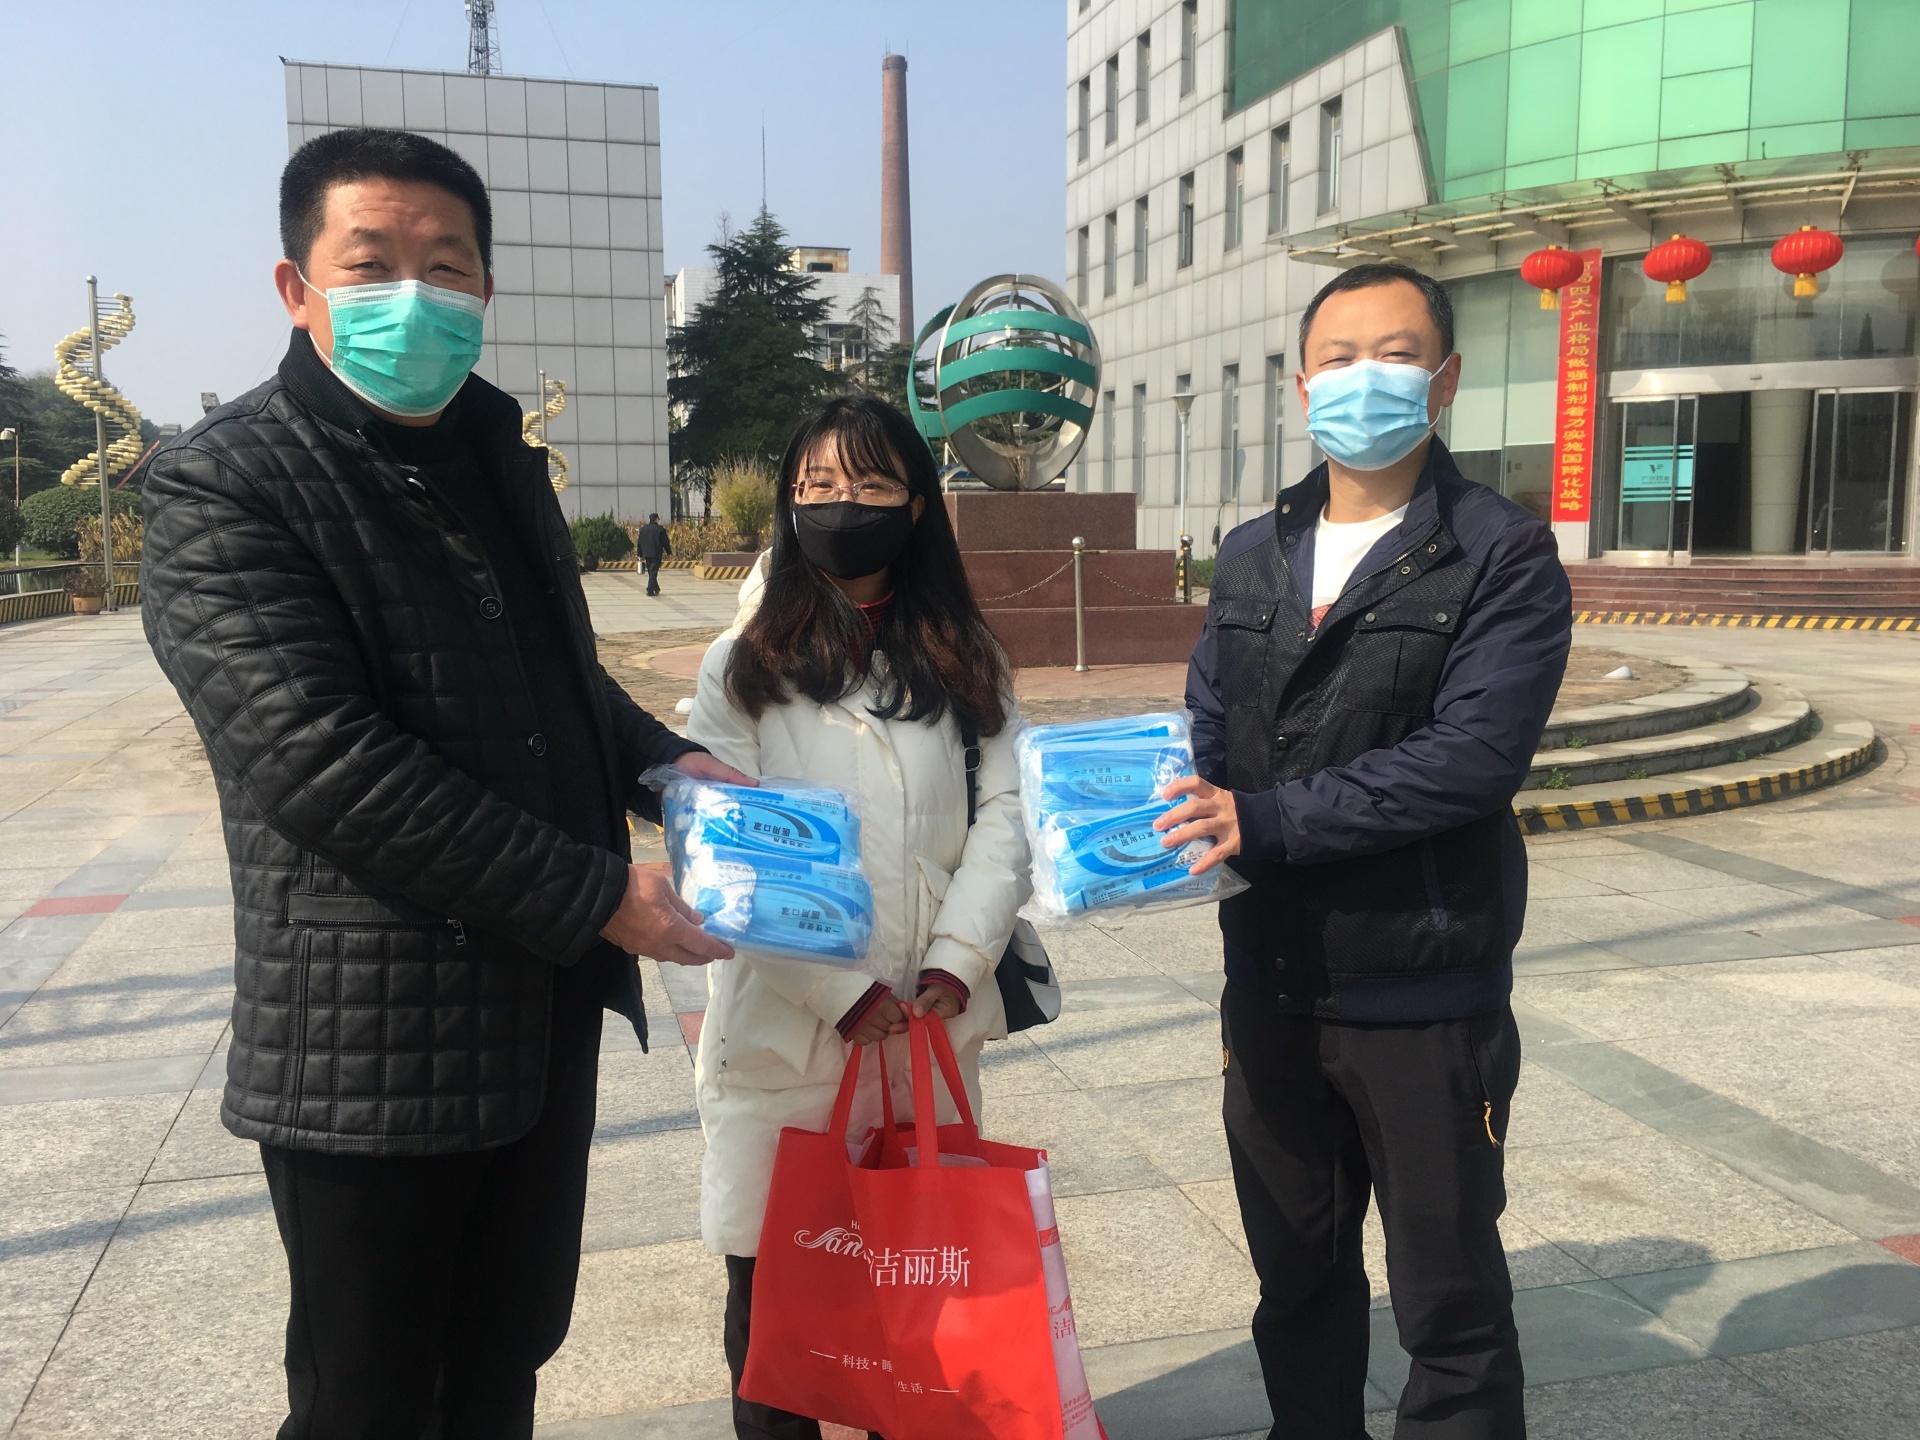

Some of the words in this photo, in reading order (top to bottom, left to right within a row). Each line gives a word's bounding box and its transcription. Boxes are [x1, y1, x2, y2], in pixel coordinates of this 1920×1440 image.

[1073, 767, 1111, 775] 一次性使用
[1095, 775, 1132, 784] 医用口罩
[753, 821, 791, 837] 医用口罩
[773, 836, 812, 848] 一次性使用
[1097, 830, 1132, 843] 一次性使用
[1120, 831, 1155, 847] 医用口罩
[781, 906, 821, 919] 医用口罩
[798, 920, 840, 933] 一次性使用
[864, 1246, 971, 1287] 洁丽斯
[1053, 1318, 1077, 1340] 洁
[897, 1381, 924, 1395] 生活
